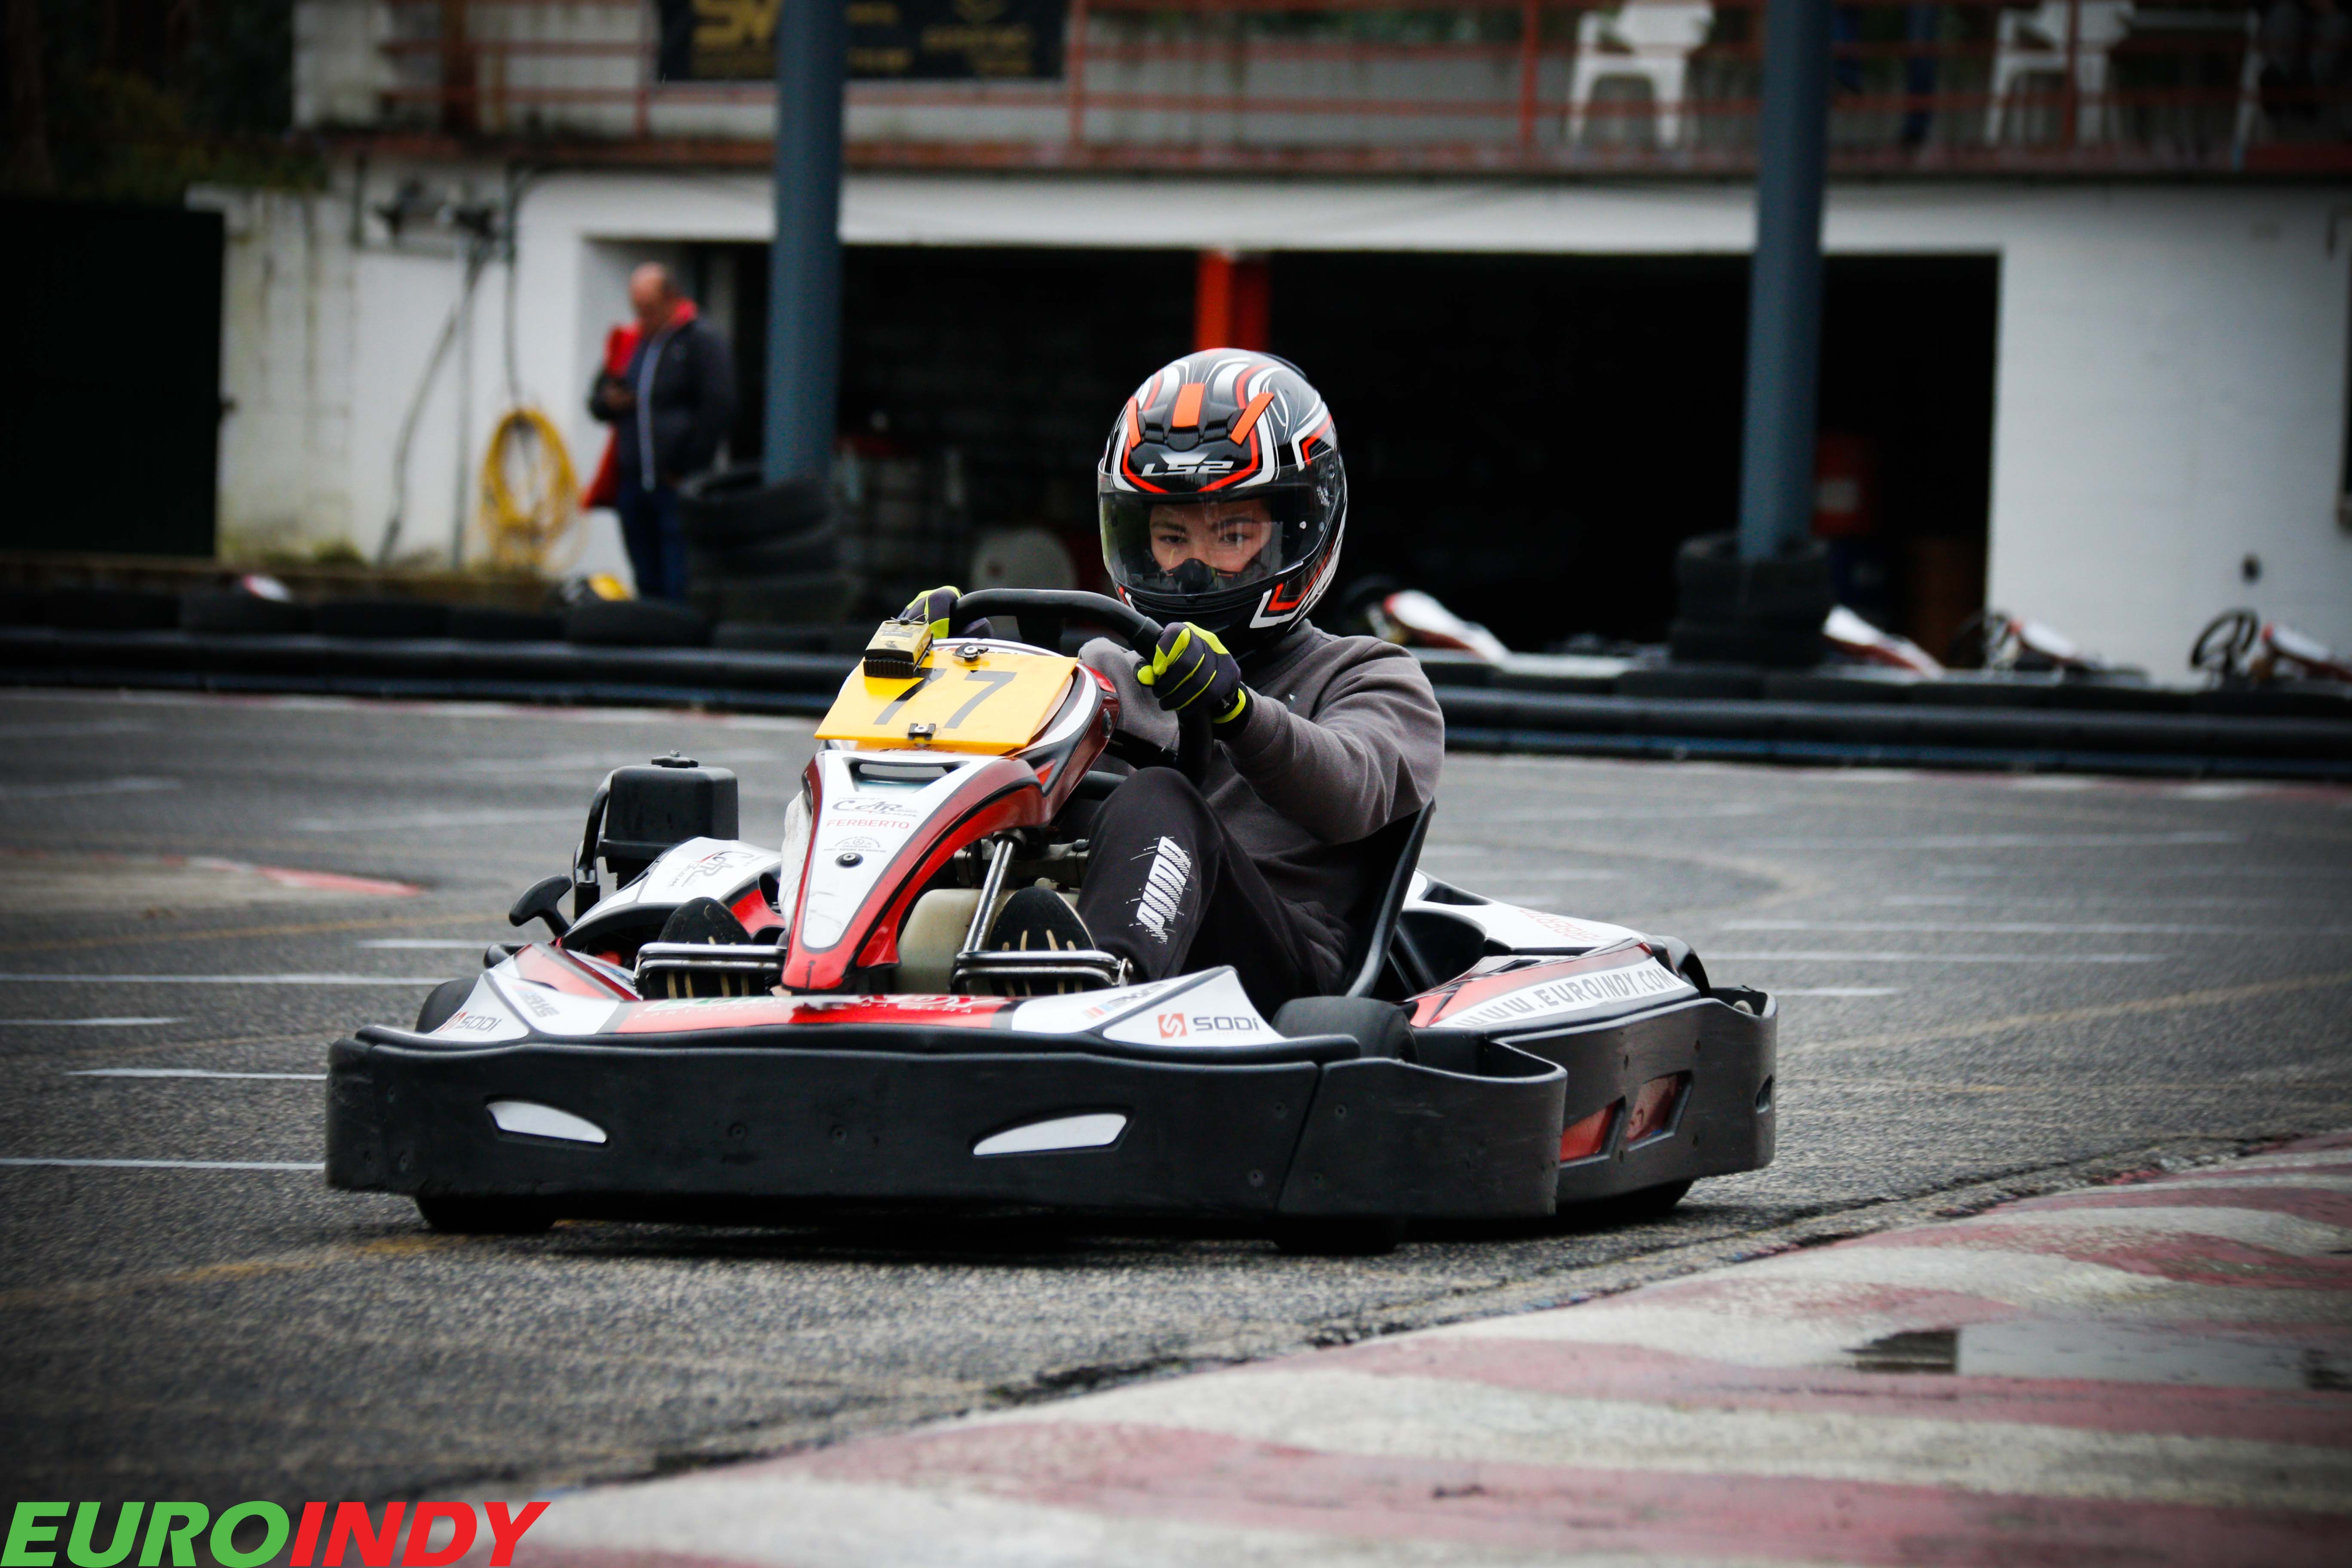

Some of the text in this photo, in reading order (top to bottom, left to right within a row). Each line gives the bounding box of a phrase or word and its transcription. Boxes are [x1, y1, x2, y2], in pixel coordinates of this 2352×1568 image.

[1141, 460, 1234, 477] LS2
[873, 667, 1017, 729] 77
[826, 819, 910, 830] FERBERTO
[1455, 968, 1677, 1027] WWW.EUROINDY.COM
